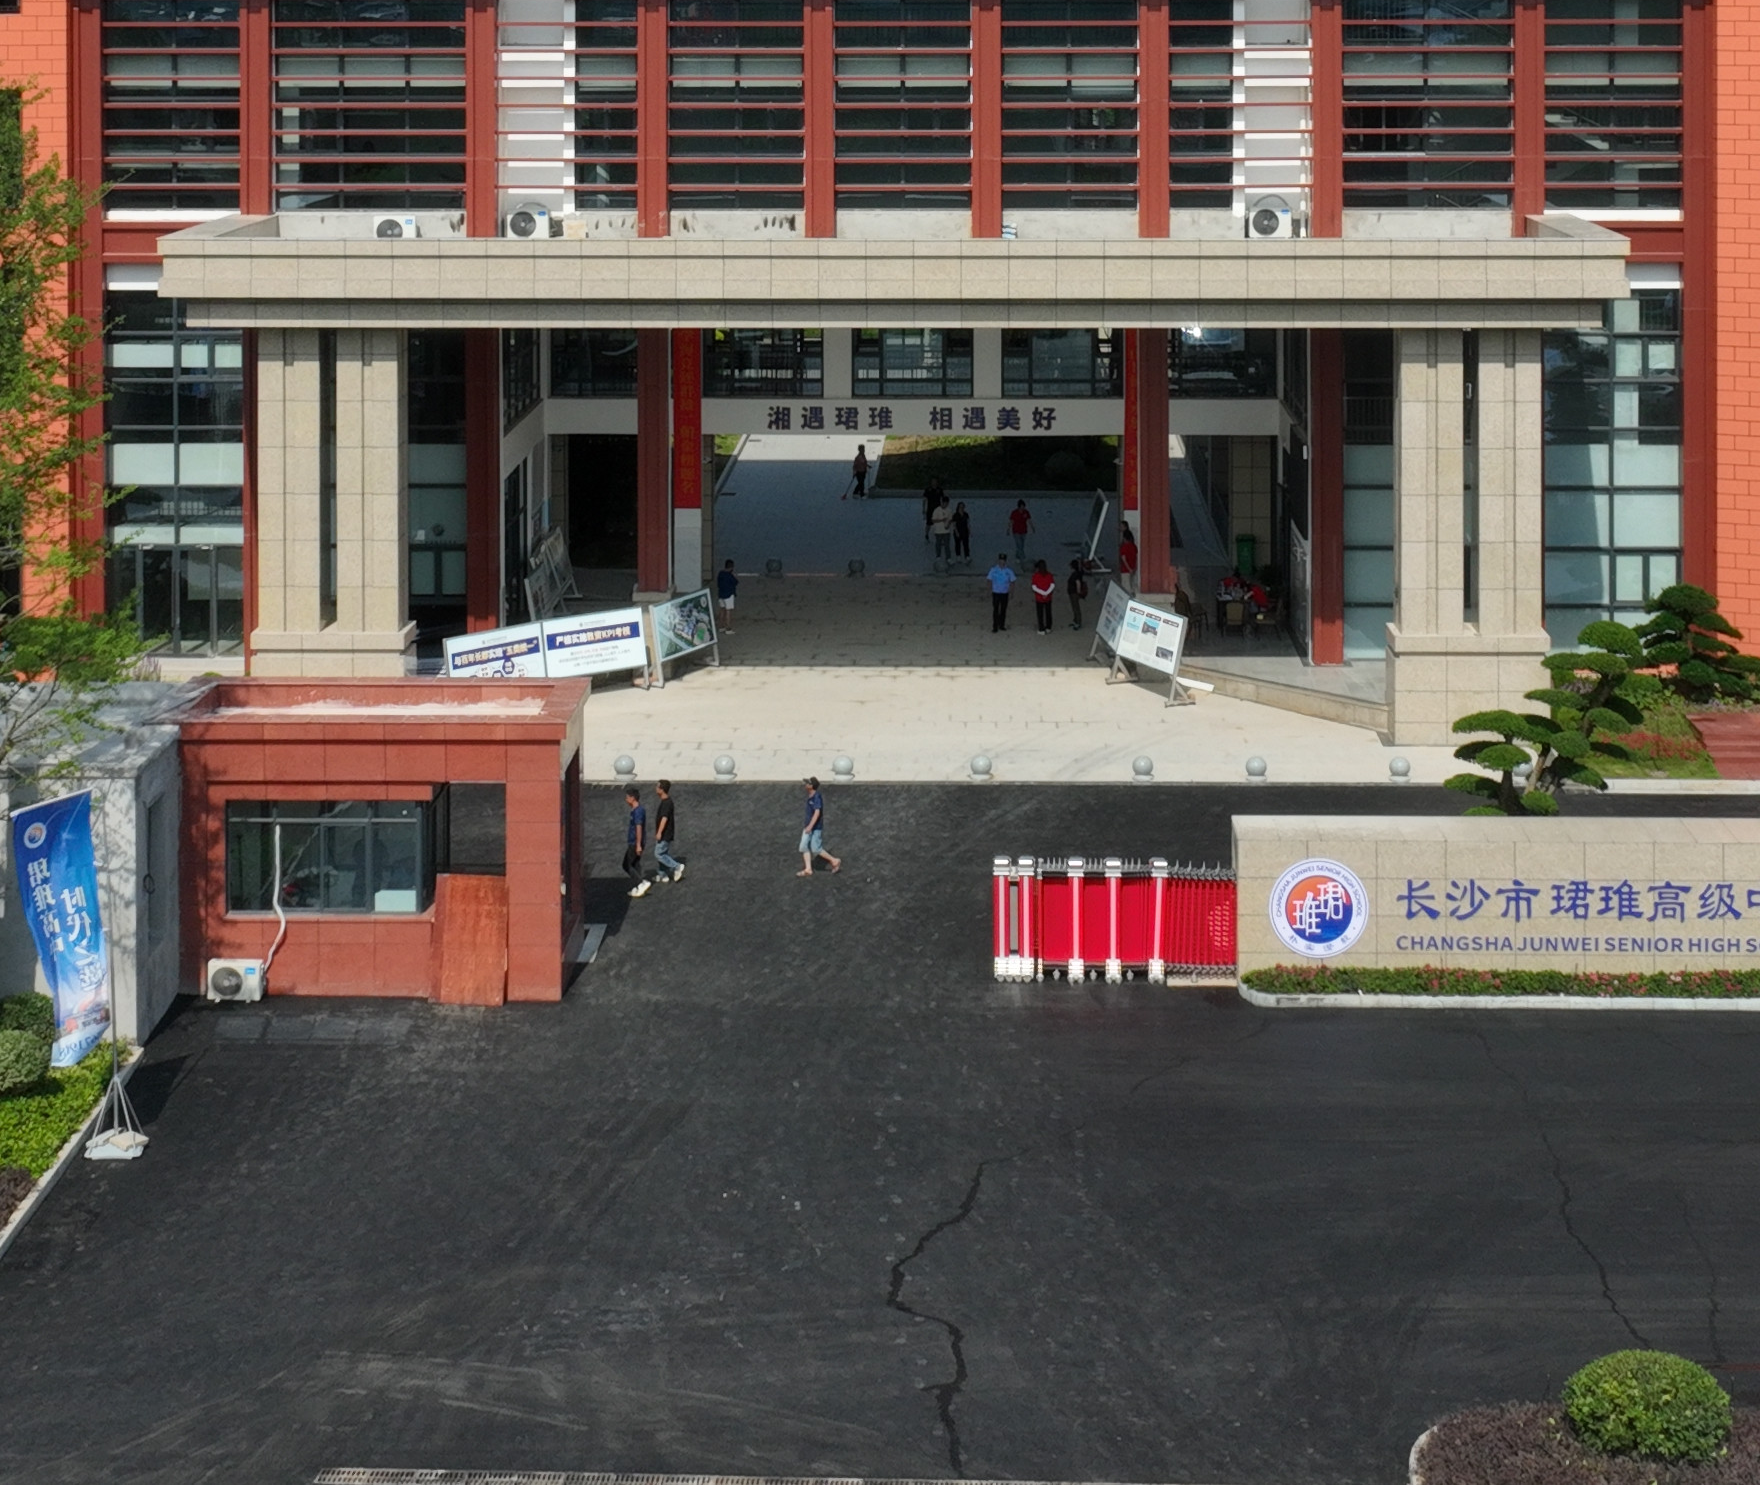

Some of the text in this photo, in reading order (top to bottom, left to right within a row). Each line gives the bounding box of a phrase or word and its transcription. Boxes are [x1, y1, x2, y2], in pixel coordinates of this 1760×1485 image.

[767, 405, 1057, 431] 湘遇珺琟 相遇美好
[1396, 936, 1514, 954] CHANGSHA
[1518, 936, 1600, 954] JUNWEI
[1604, 936, 1684, 954] SENIOR
[1686, 936, 1742, 954] HIGH
